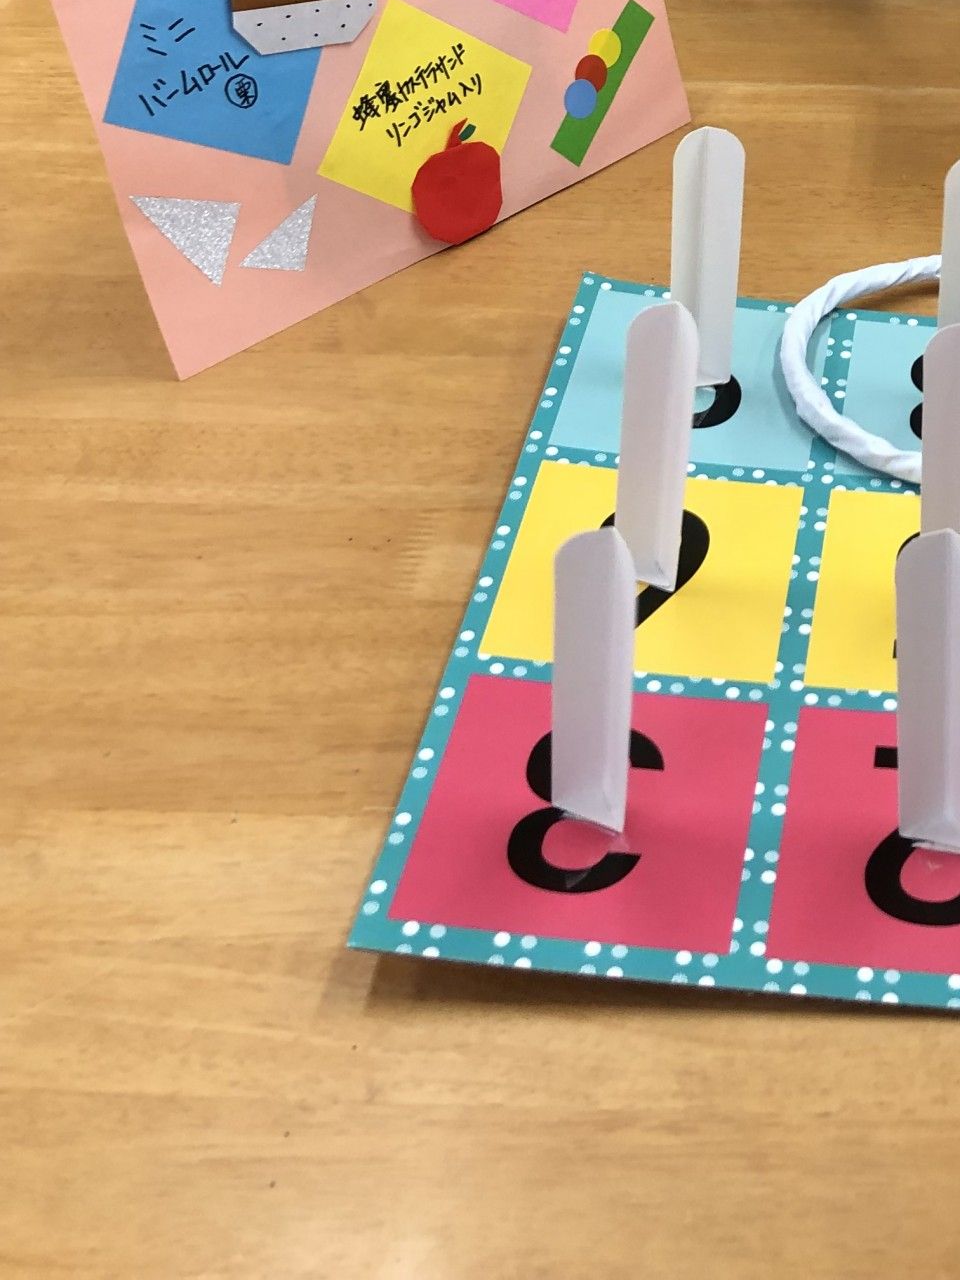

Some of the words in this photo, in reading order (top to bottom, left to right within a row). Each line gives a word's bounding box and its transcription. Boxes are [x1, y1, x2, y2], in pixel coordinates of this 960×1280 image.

[140, 17, 196, 57] ミニ
[138, 51, 250, 117] バームロール
[351, 42, 466, 132] 蜂蜜カステラサンド
[385, 73, 483, 148] リンゴジャム入り
